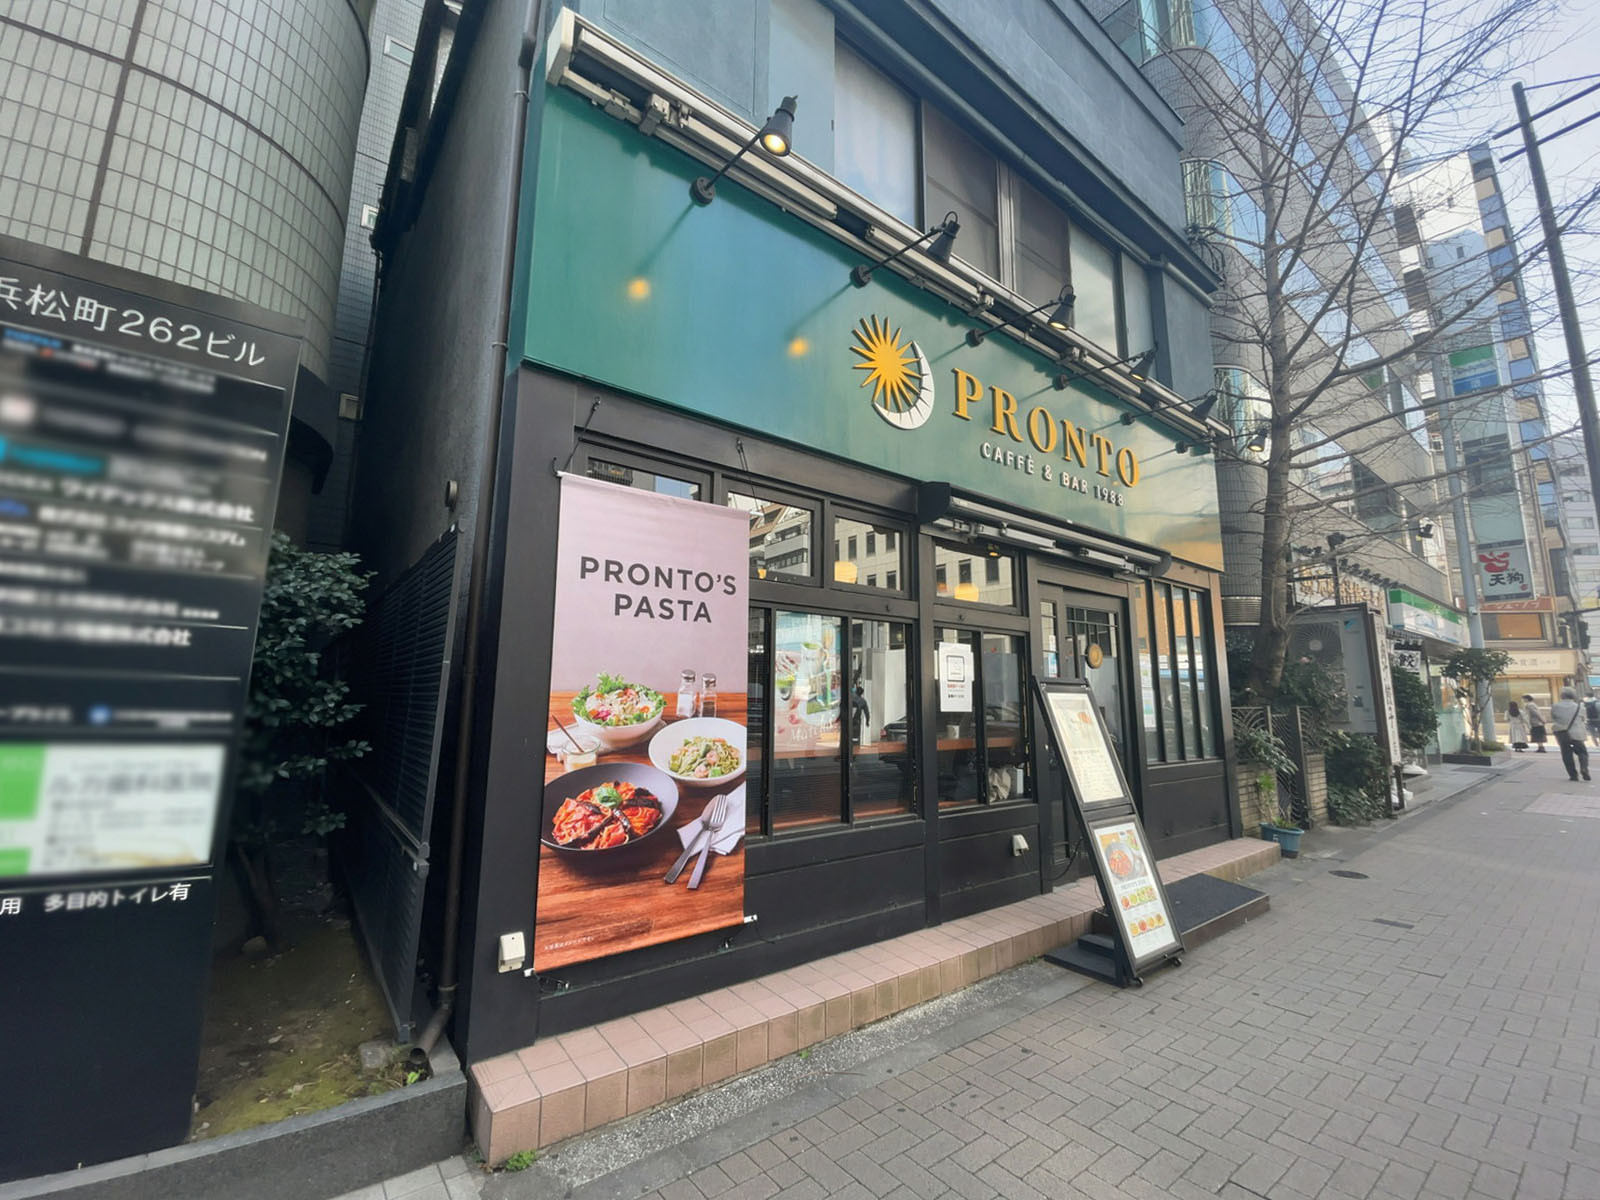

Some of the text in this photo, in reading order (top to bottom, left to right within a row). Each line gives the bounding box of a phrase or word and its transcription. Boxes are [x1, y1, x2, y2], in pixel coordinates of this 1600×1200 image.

[952, 367, 1140, 488] PRONTO
[981, 441, 1125, 507] CAFFÈ & BAR 1988
[579, 556, 737, 596] PRONTO'S
[1488, 572, 1525, 587] 天狗
[614, 594, 713, 624] PASTA
[44, 882, 192, 913] 多目的トイレ有
